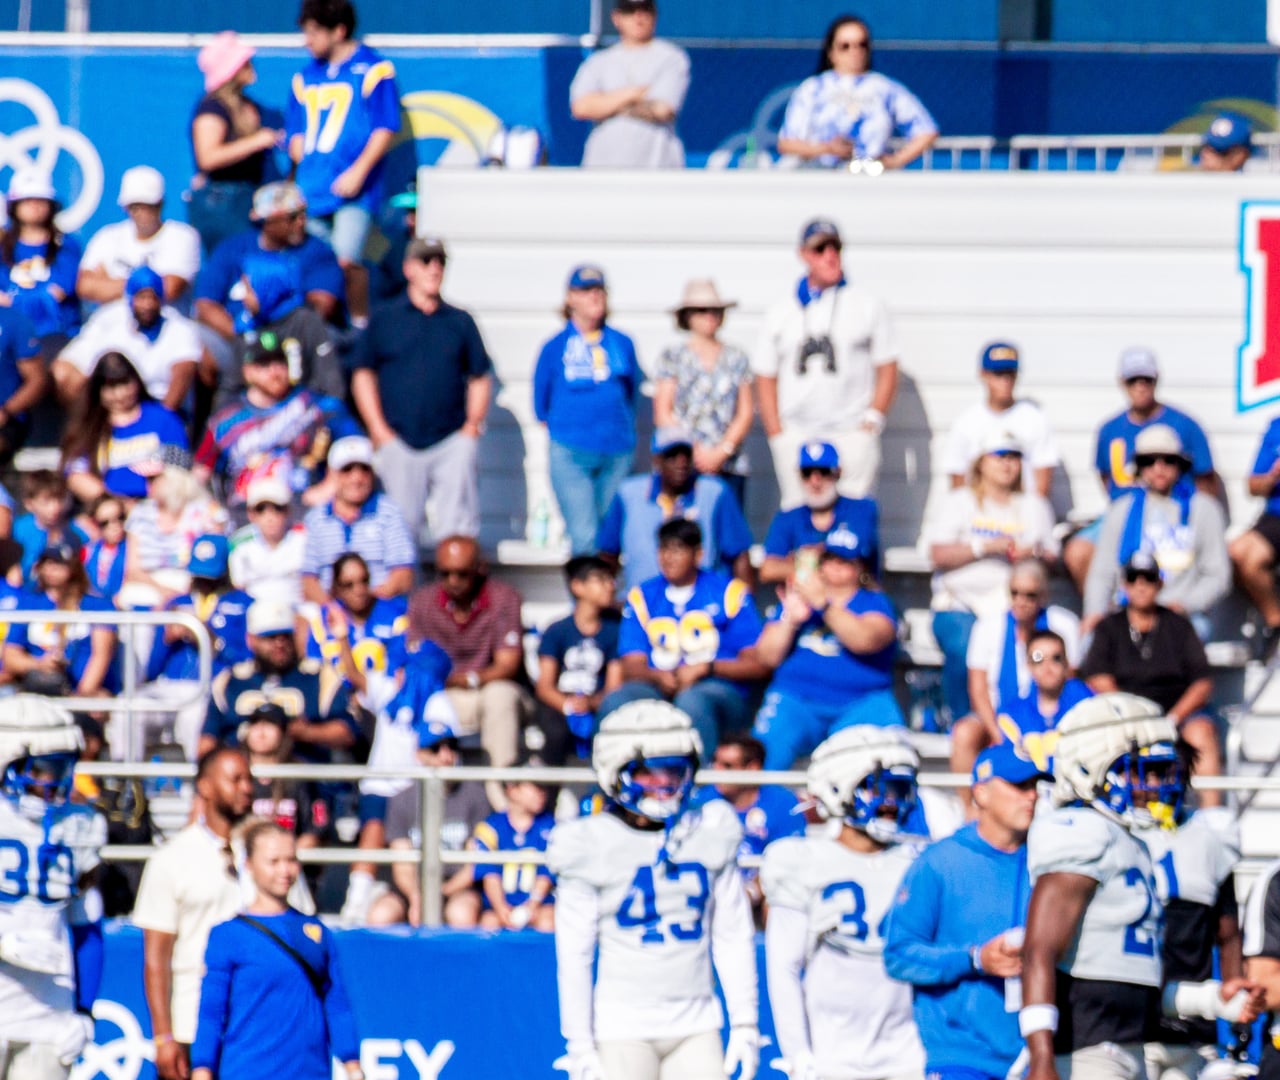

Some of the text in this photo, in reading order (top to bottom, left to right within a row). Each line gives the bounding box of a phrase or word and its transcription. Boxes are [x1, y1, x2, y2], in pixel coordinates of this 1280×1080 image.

[303, 83, 354, 155] 17
[616, 864, 709, 945] 43
[1123, 866, 1161, 957] 2
